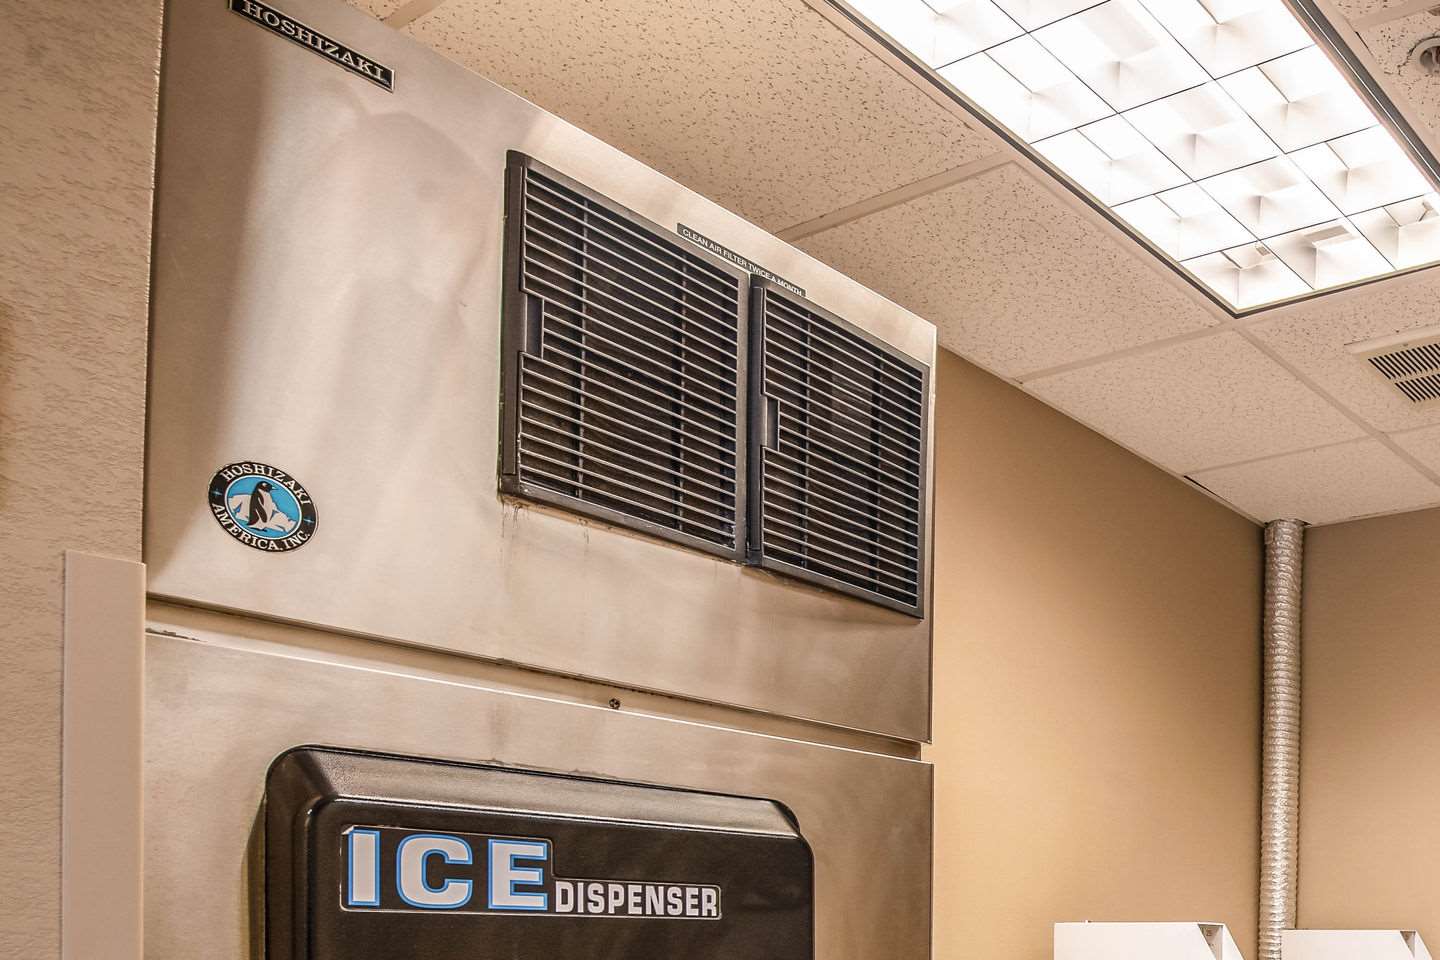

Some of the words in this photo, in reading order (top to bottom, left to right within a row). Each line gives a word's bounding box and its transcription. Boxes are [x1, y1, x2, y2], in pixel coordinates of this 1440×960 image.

[241, 0, 385, 80] HOSHIZAKI
[682, 228, 708, 247] CLEAN
[709, 242, 722, 254] AIR
[723, 247, 747, 268] FILTER
[748, 263, 771, 279] TWICE
[221, 463, 311, 505] HOSHIZAKI
[348, 828, 548, 911] ICE
[555, 880, 718, 917] DISPENSER
